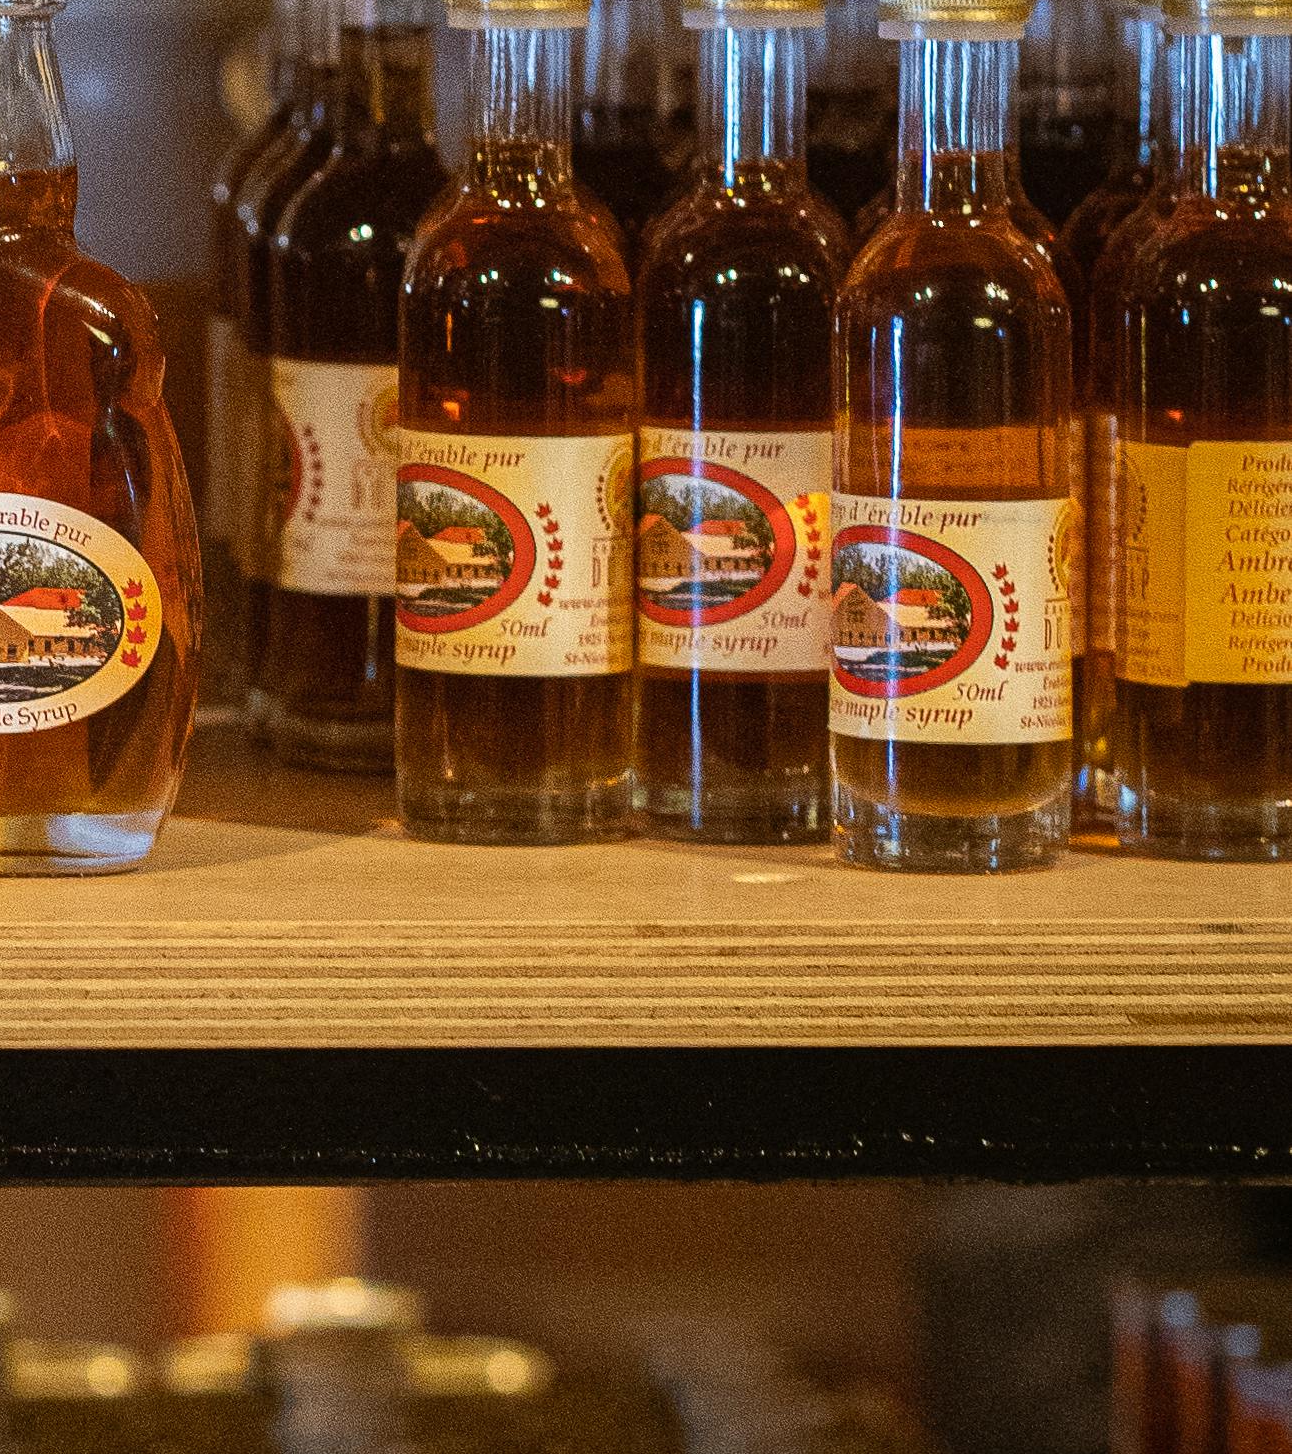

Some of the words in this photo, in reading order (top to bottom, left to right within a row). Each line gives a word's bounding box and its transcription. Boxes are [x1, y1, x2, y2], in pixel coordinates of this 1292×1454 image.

[483, 450, 526, 470] pur
[744, 441, 786, 460] pur
[941, 509, 982, 528] pur
[53, 521, 93, 547] pur
[500, 620, 551, 639] 50ml
[761, 610, 810, 629] 50ml
[455, 641, 517, 665] syrup
[956, 682, 1008, 702] 50ml
[17, 700, 78, 733] Syrup
[906, 707, 973, 734] syrup
